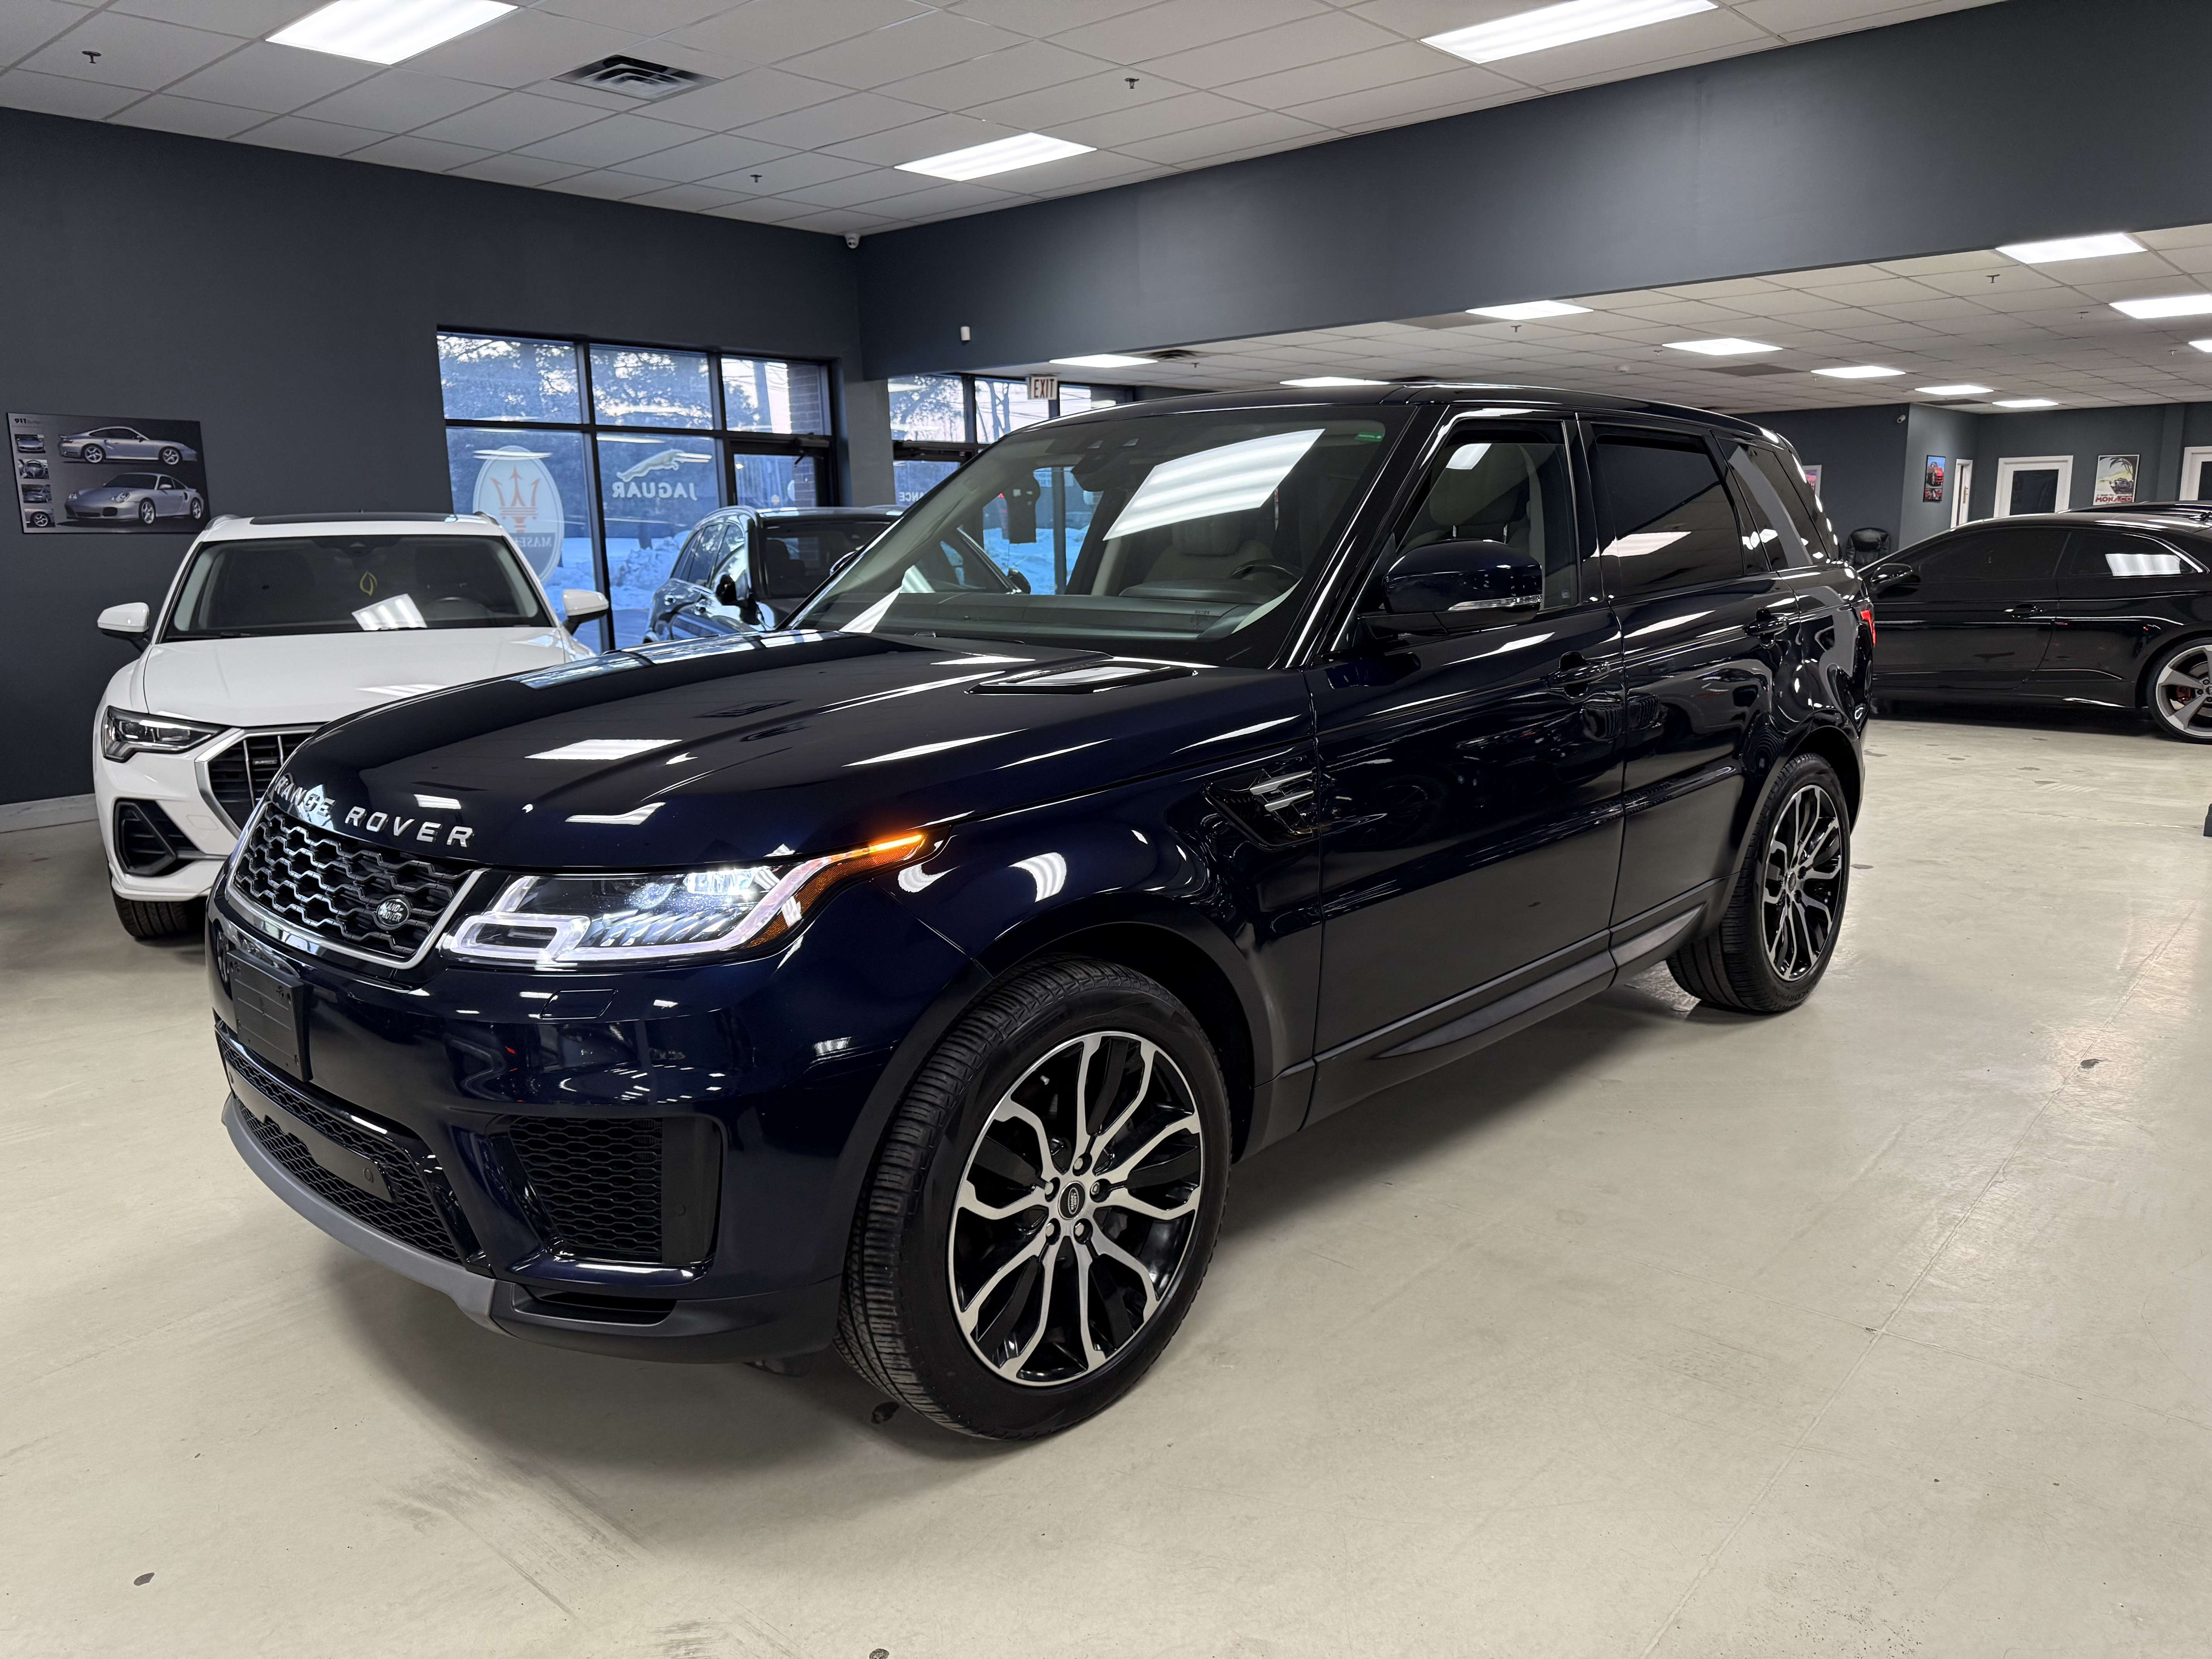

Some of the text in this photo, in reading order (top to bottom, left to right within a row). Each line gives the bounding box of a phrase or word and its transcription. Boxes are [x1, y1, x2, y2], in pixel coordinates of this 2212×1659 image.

[1034, 379, 1054, 398] EXIT
[275, 775, 475, 848] RANGE ROVER
